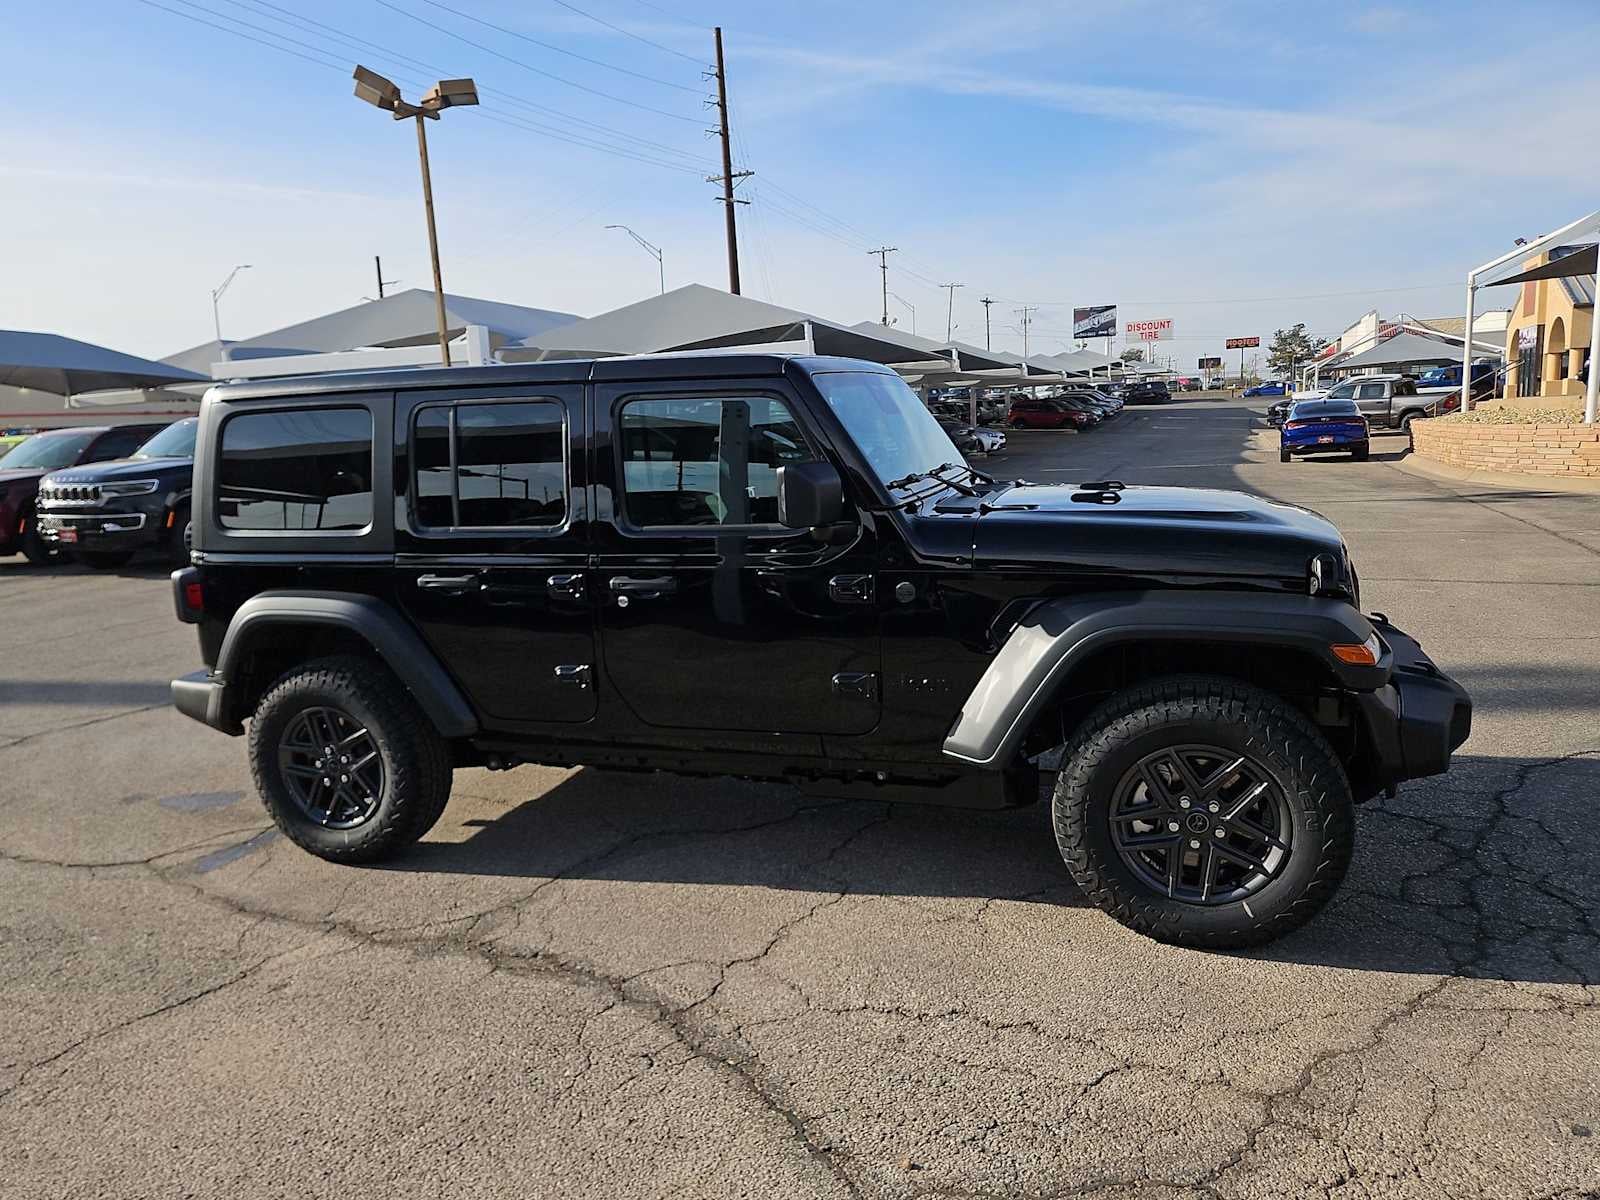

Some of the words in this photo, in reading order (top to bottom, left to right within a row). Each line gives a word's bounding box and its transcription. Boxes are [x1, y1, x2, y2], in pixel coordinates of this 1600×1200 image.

[1127, 321, 1171, 332] DISCOUNT
[1139, 331, 1159, 340] TIRE
[1226, 338, 1259, 347] HOOTERS
